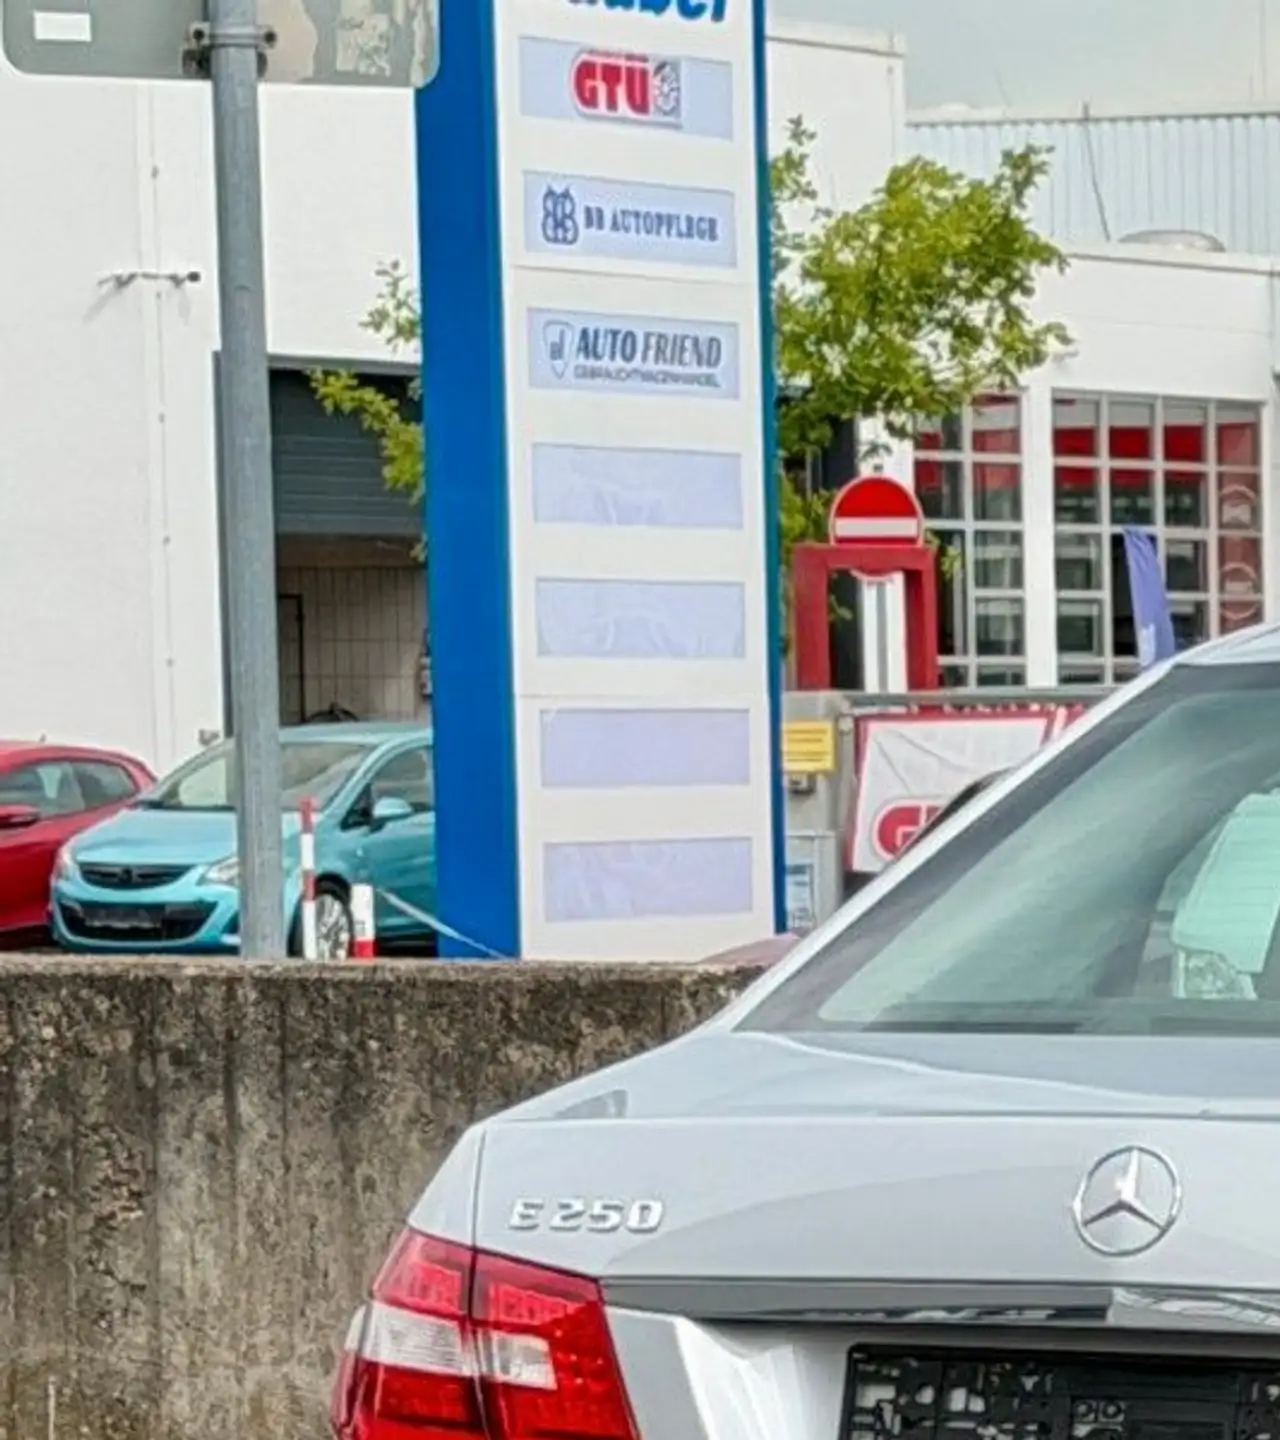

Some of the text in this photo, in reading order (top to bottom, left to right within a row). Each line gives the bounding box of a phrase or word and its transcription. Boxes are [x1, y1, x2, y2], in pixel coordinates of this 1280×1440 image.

[576, 326, 722, 368] AUTO FRIEND
[508, 1197, 665, 1235] E 250
